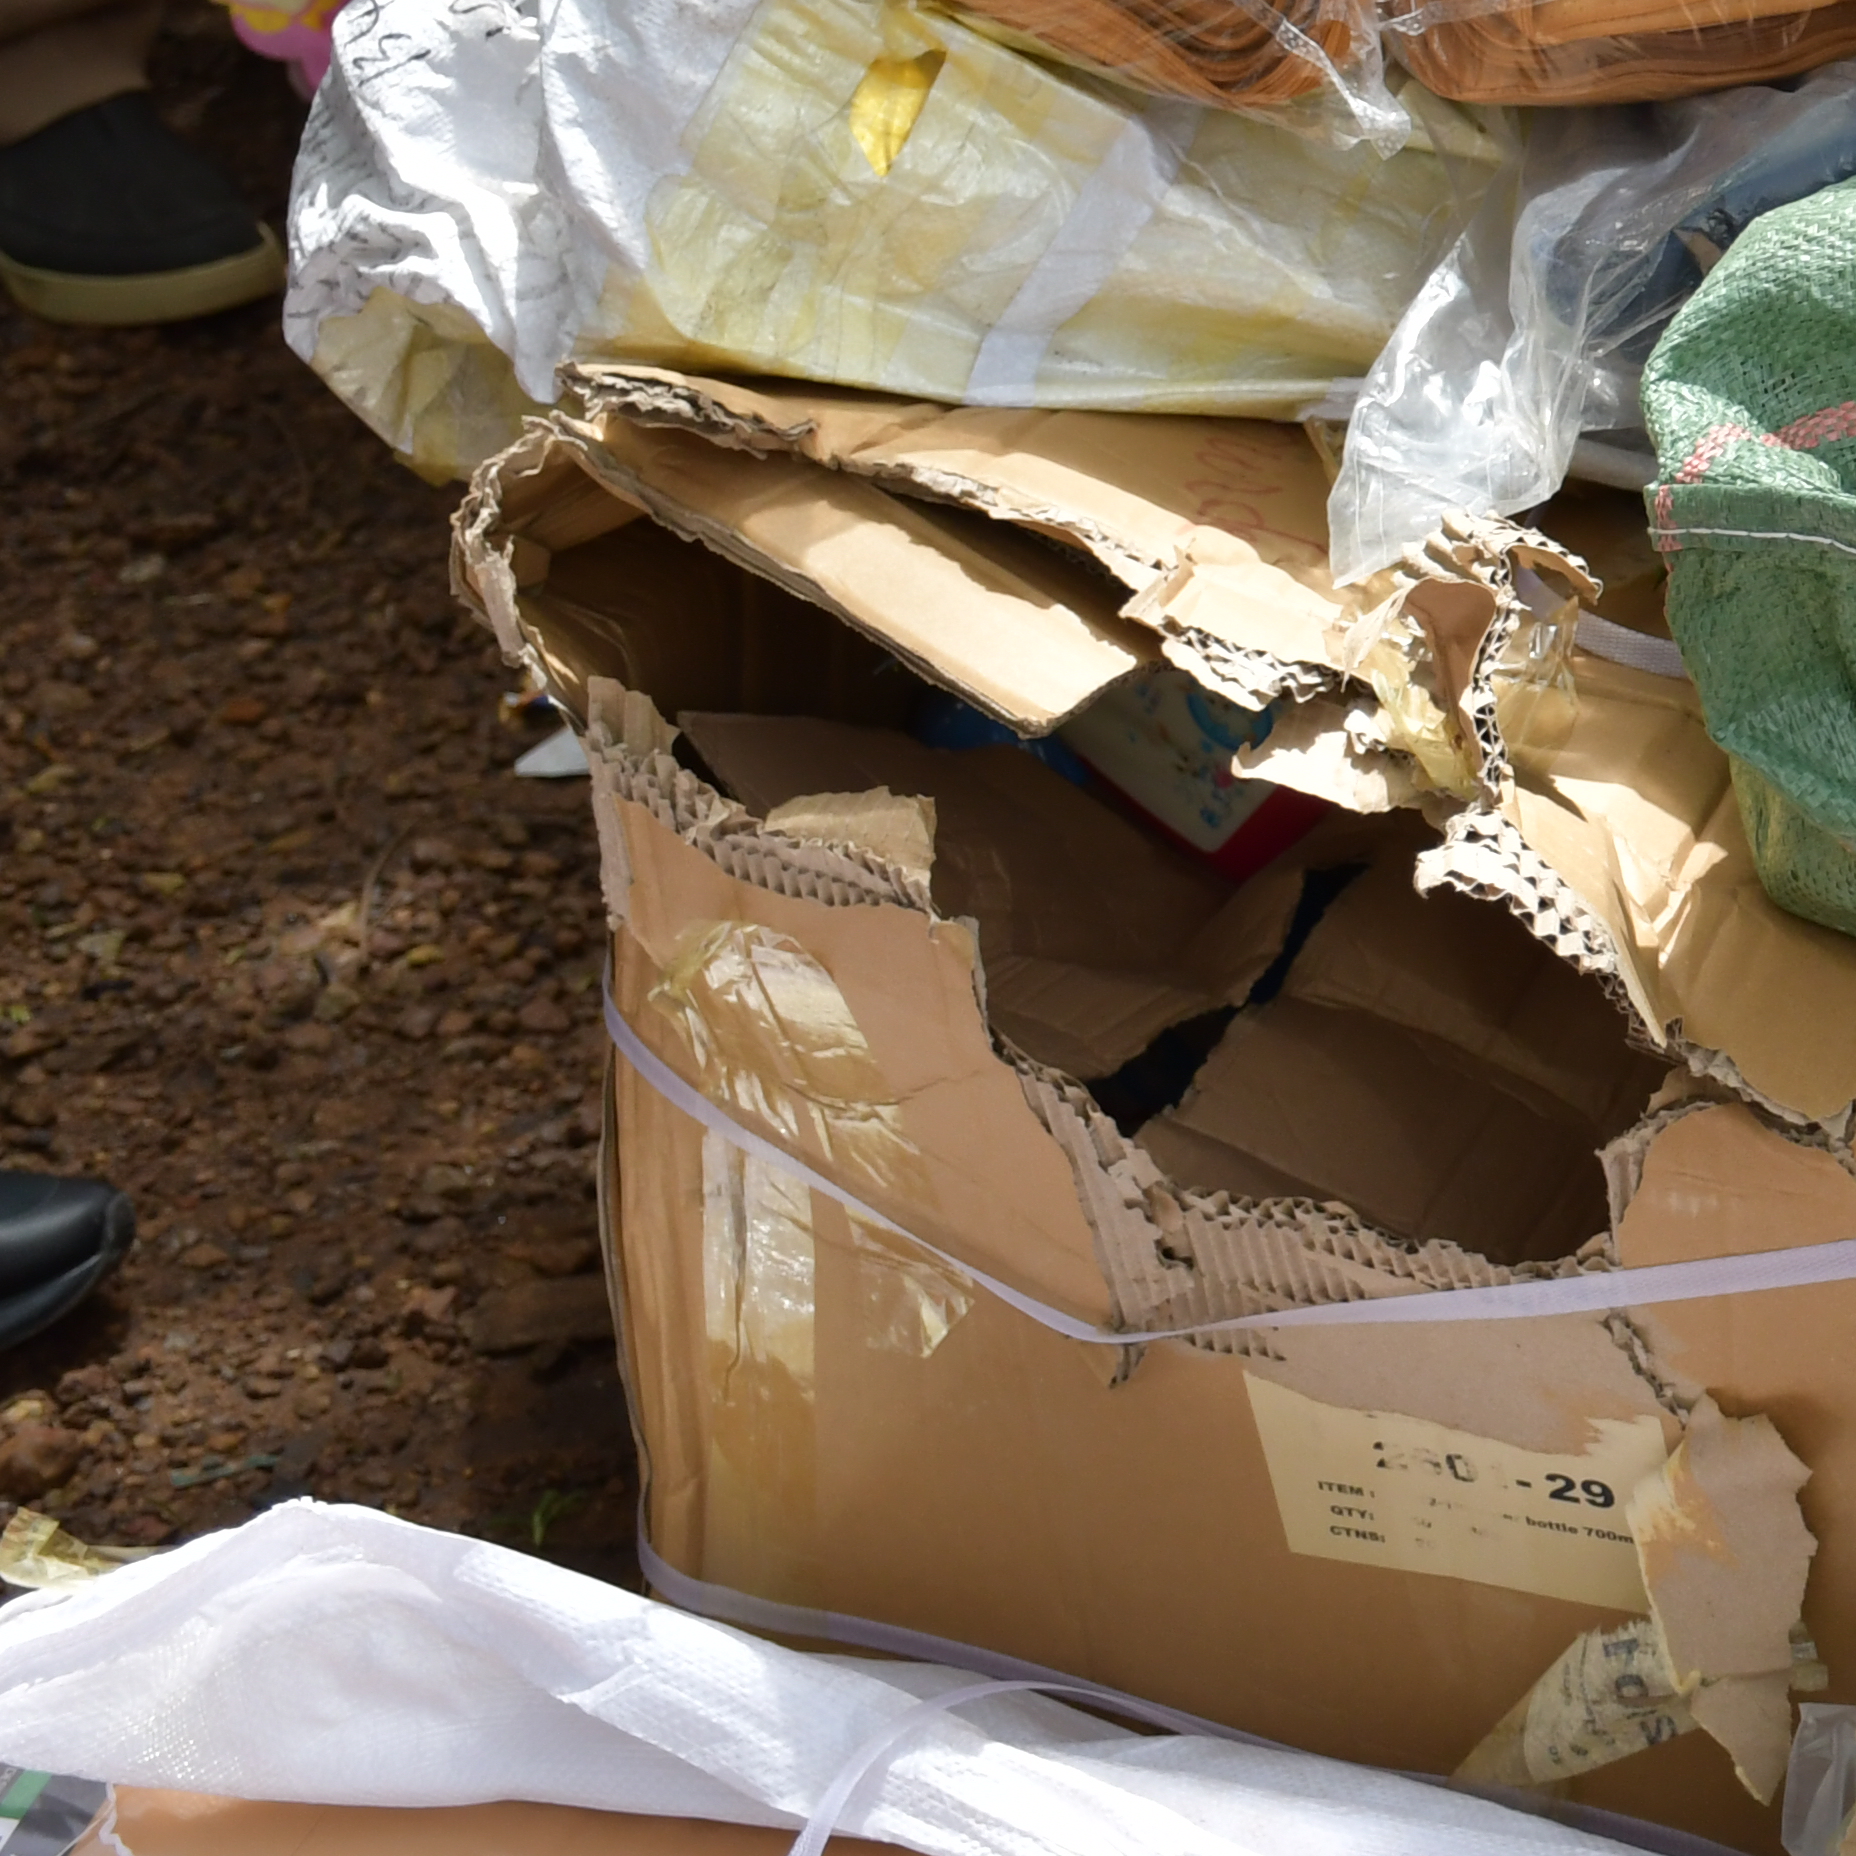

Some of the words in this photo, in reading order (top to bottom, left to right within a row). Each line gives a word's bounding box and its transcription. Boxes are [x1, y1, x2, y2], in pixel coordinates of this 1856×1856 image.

[1544, 1472, 1617, 1510] 29
[1329, 1503, 1376, 1523] QTY:
[1328, 1524, 1387, 1545] CTNS:
[1524, 1514, 1580, 1536] bottle
[1584, 1525, 1636, 1546] 700m
